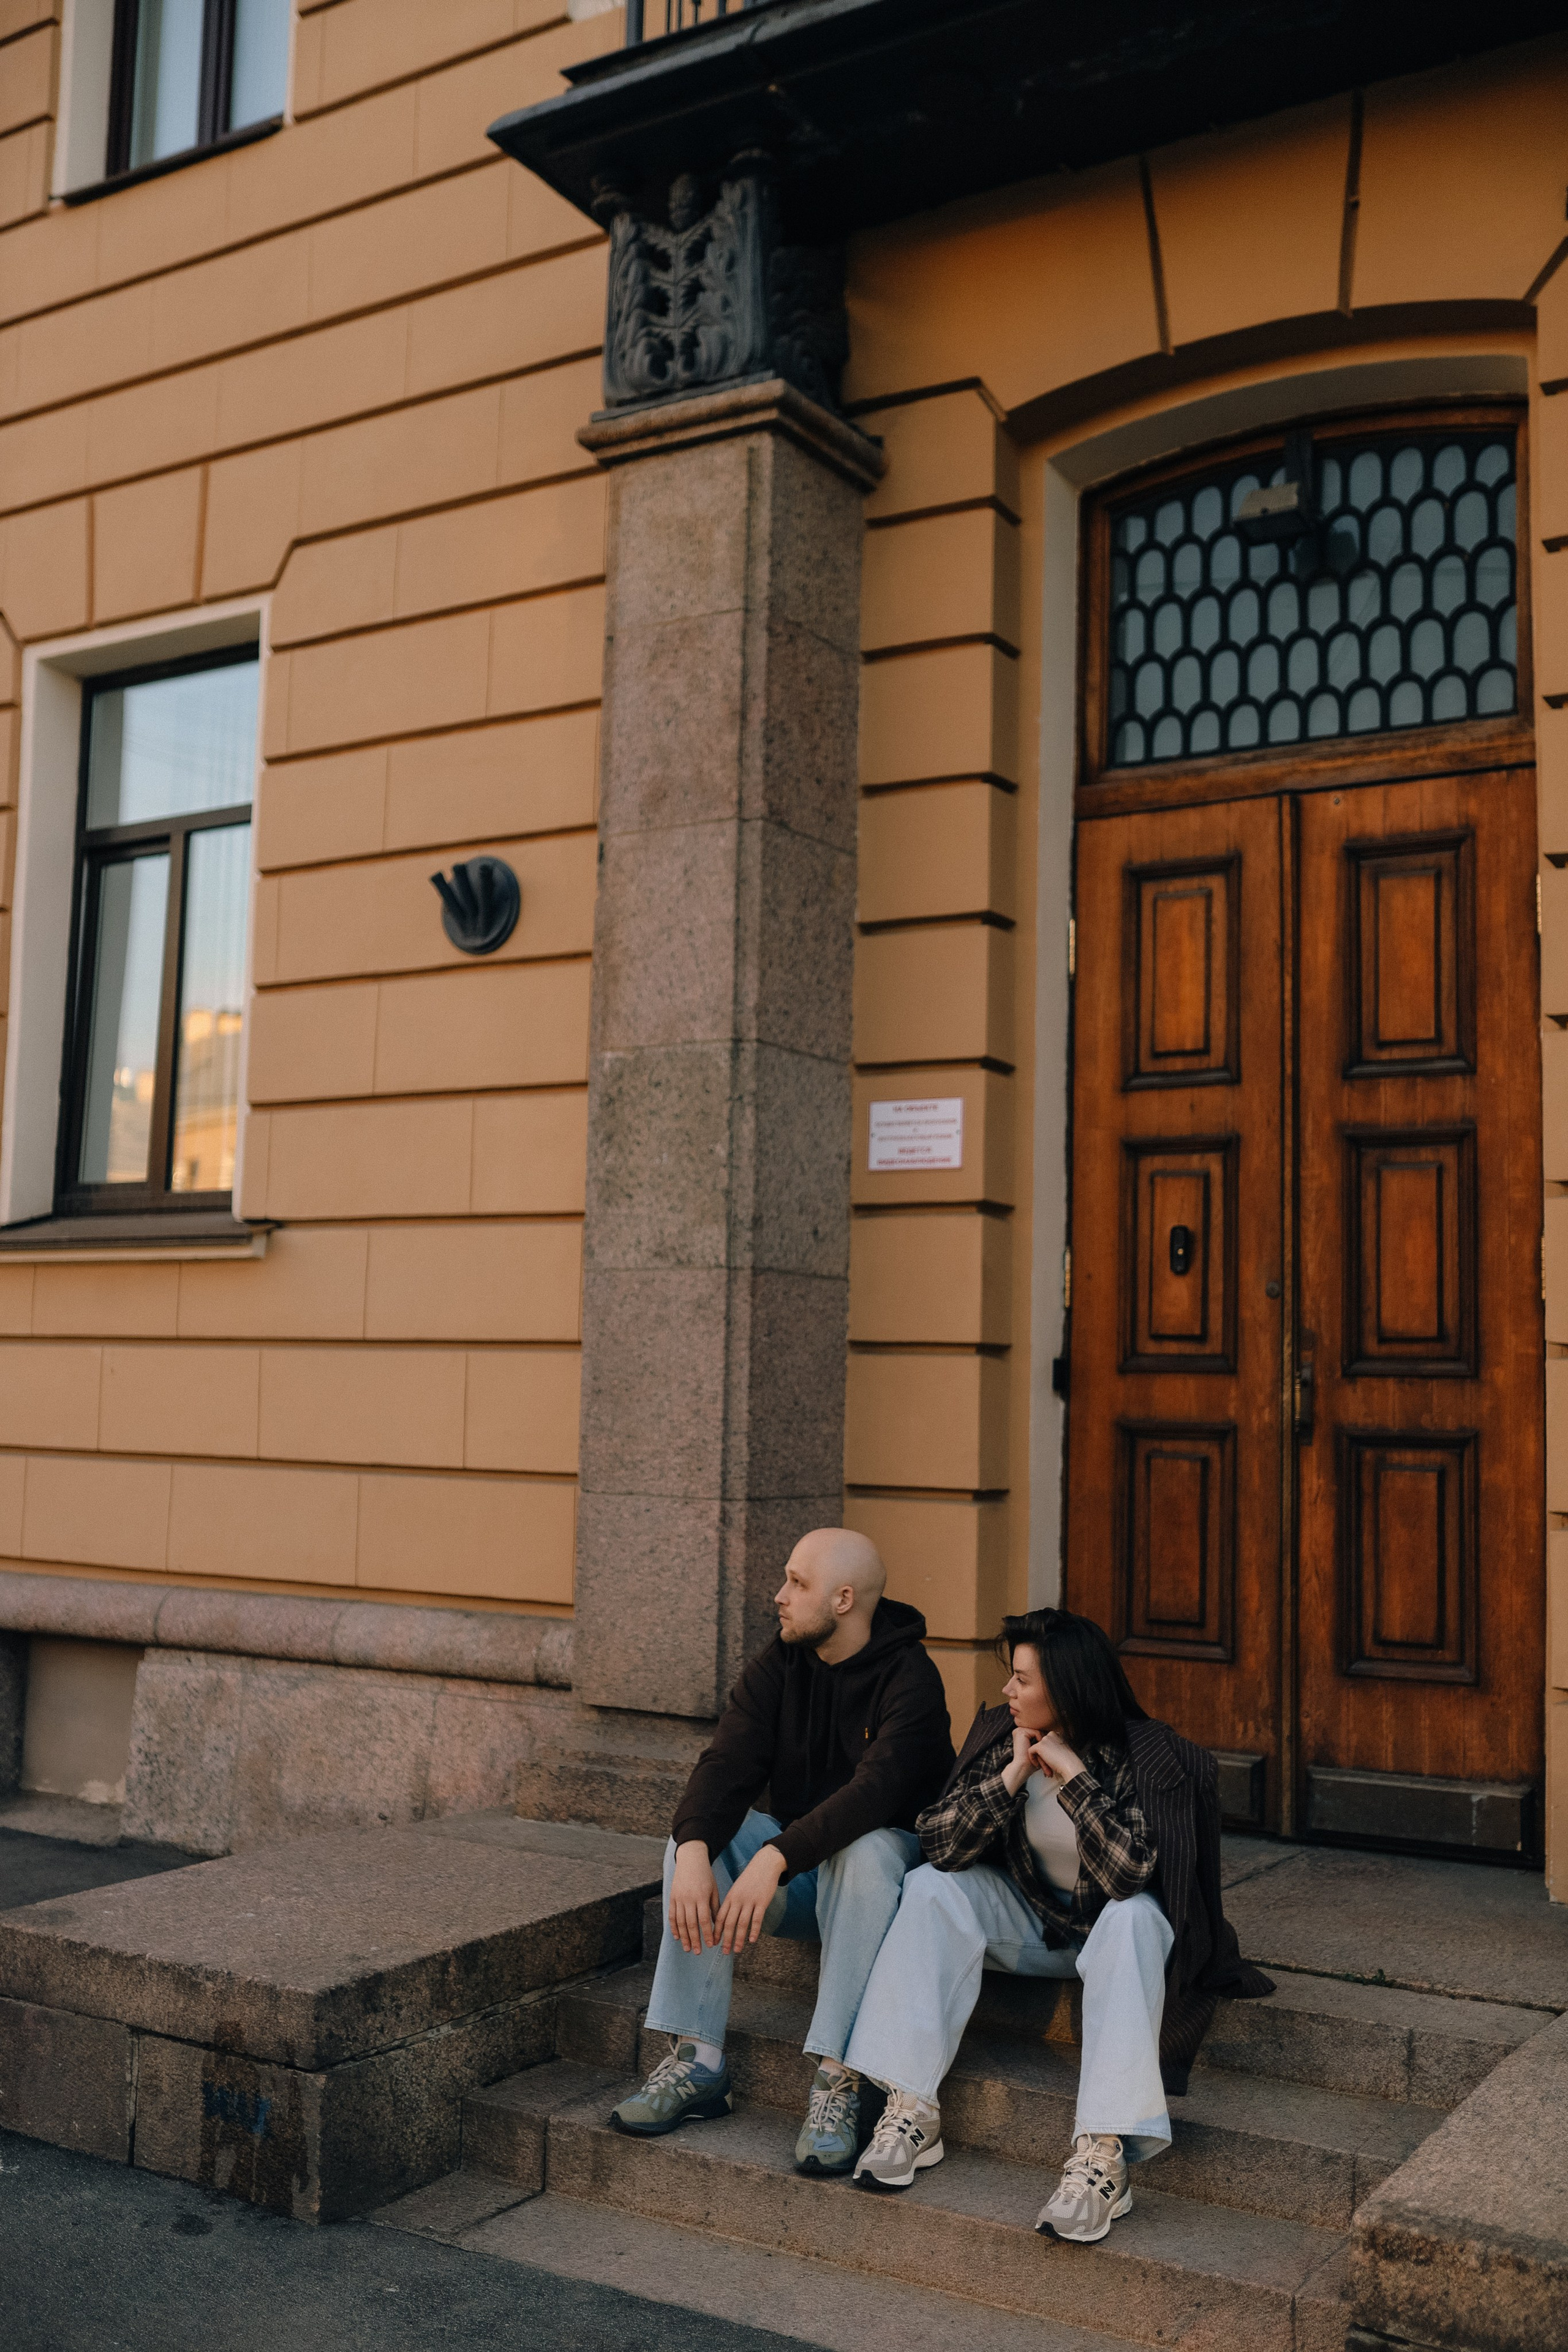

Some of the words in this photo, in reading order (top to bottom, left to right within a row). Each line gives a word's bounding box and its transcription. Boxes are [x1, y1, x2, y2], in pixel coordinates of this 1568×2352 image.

[676, 2081, 697, 2101] N
[845, 2110, 857, 2129] N
[909, 2127, 925, 2150] N
[1099, 2178, 1117, 2201] N
